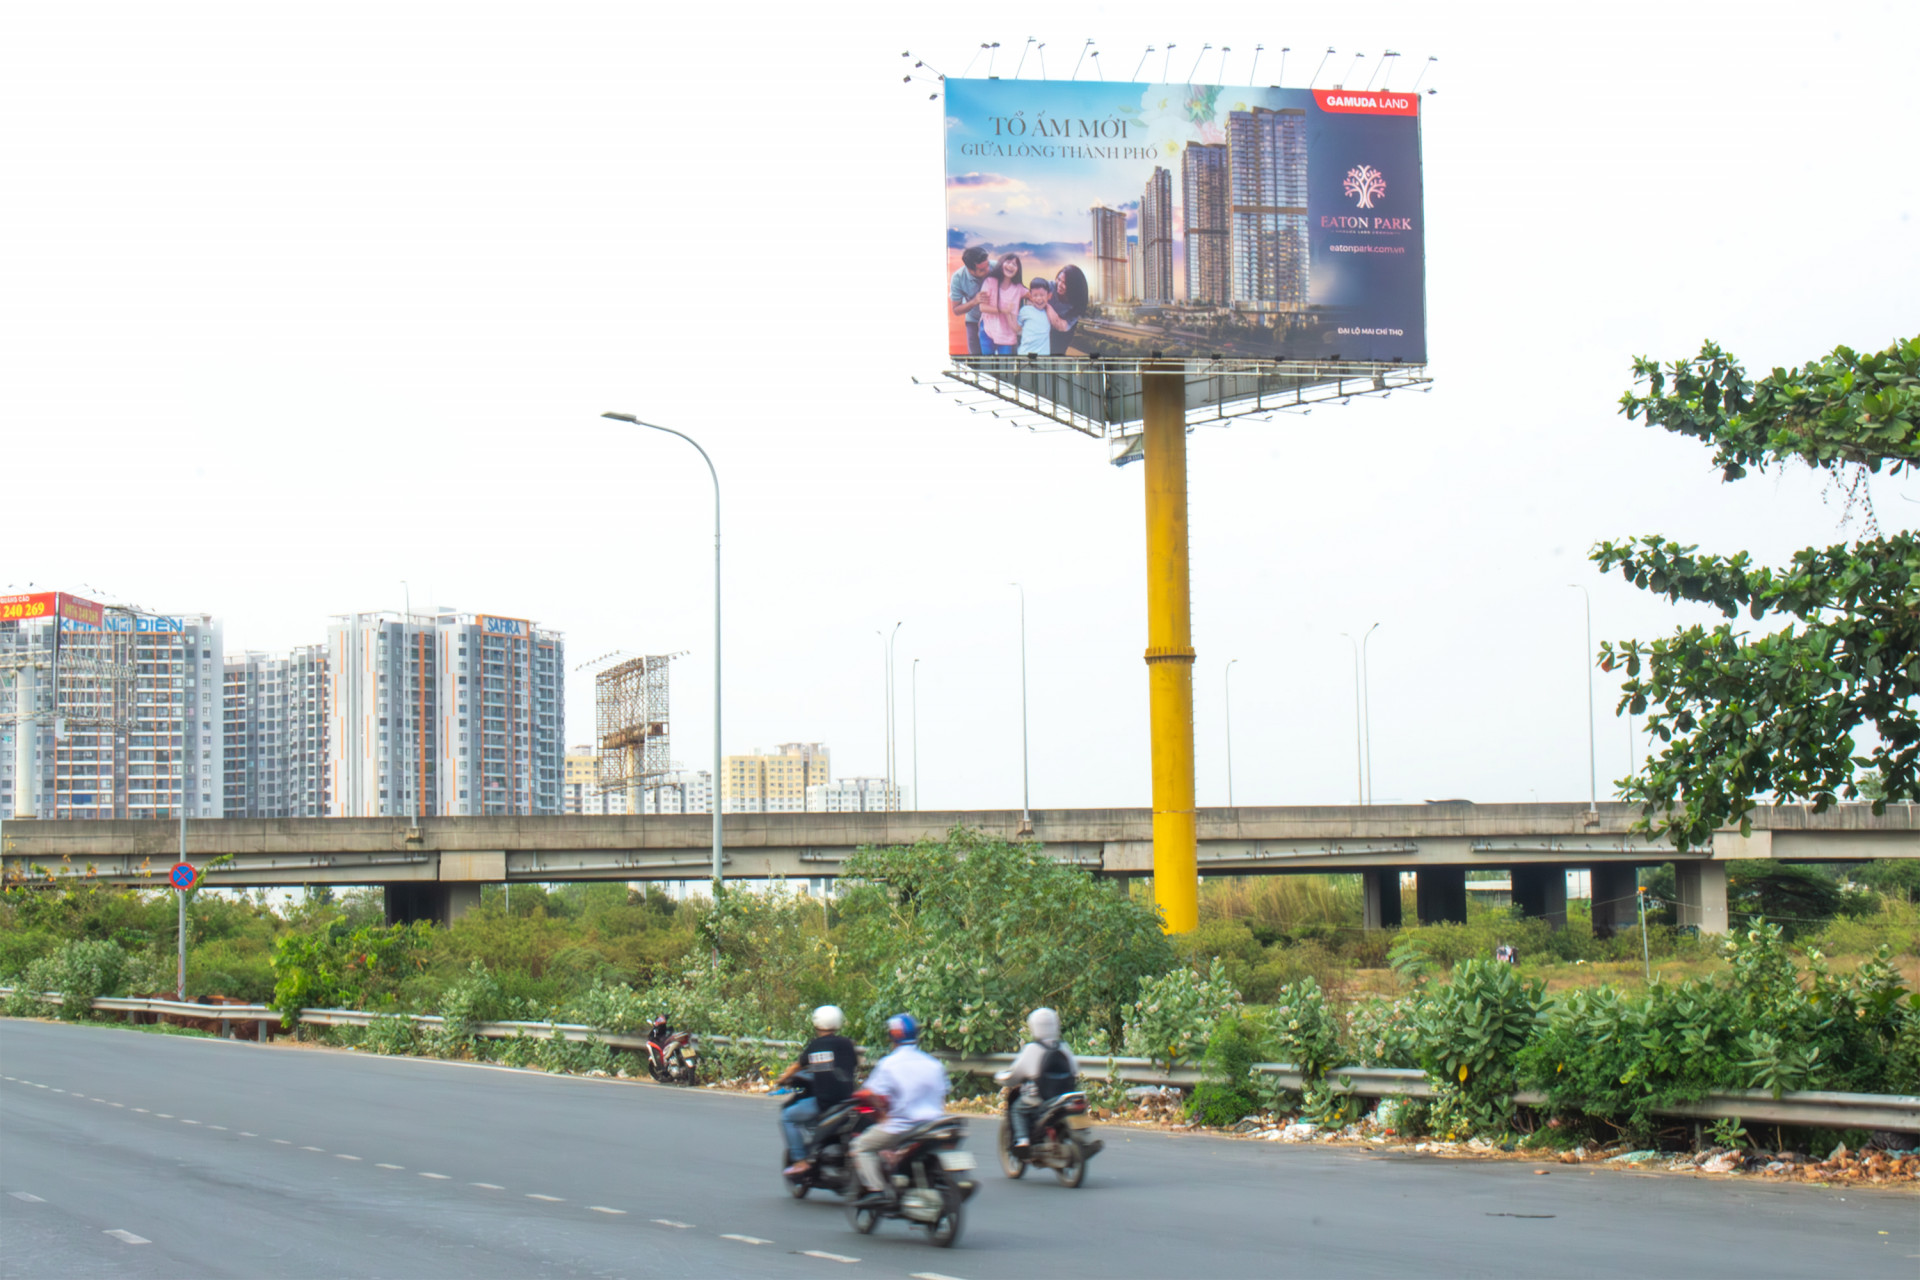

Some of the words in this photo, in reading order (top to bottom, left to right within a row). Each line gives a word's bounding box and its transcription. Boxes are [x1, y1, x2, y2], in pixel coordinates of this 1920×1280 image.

[1327, 96, 1377, 108] GAMUDA
[1379, 98, 1409, 109] LAND
[988, 110, 1026, 136] TỔ
[1031, 110, 1070, 137] ẤM
[1078, 113, 1127, 138] MỚI
[961, 140, 1004, 157] GIỮA
[1008, 142, 1054, 158] LÒNG
[1057, 142, 1118, 159] THÀNH
[1124, 143, 1158, 160] PHỐ
[1320, 216, 1369, 229] EATON
[1374, 217, 1412, 230] PARK
[1329, 245, 1405, 254] eatonpark.com.vn
[3, 604, 23, 618] 240
[25, 601, 45, 617] 269
